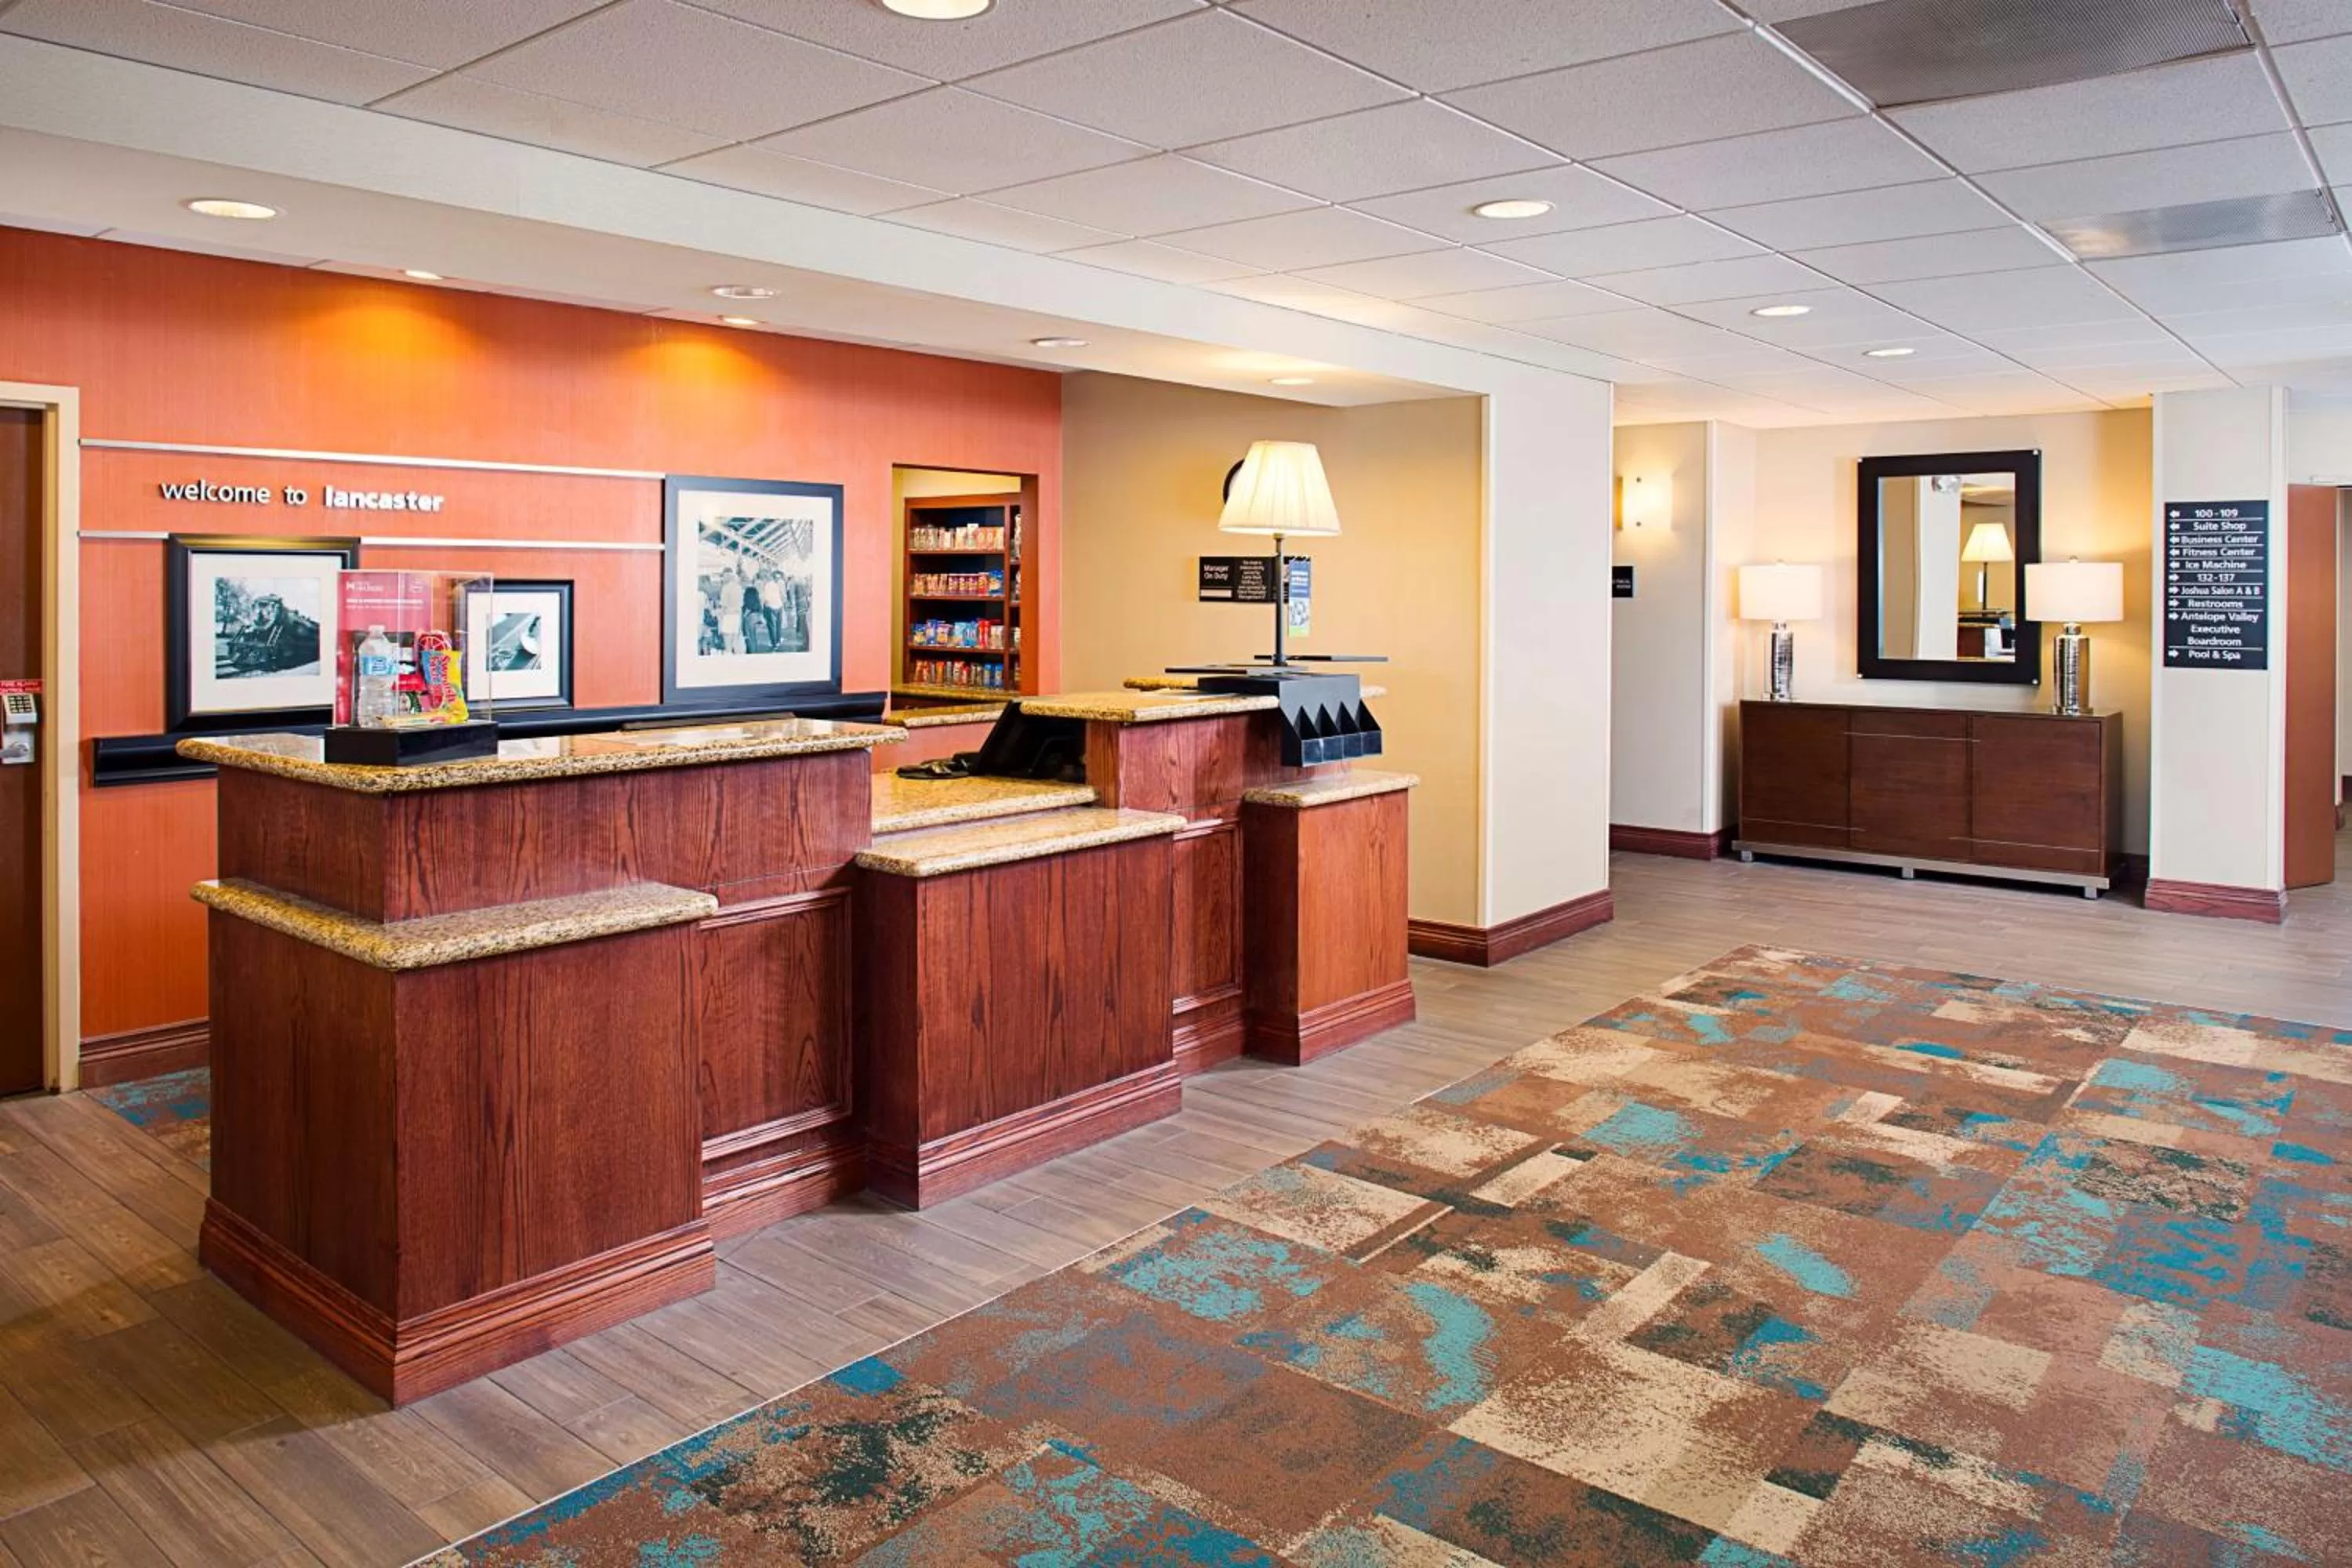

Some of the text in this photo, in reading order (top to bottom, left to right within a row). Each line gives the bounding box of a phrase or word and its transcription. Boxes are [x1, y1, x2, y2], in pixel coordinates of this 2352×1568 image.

[159, 479, 445, 512] welcome to lancaster
[2193, 521, 2247, 532] Suite Shop
[2180, 535, 2259, 544] Business Center
[2220, 548, 2256, 557] Center
[2185, 561, 2247, 569] Ice Machine
[2180, 586, 2261, 595] Joshua Salon A & B
[2187, 599, 2244, 608] Restrooms
[2180, 612, 2259, 623] Antelope Valley
[2190, 624, 2241, 634] Executive
[2187, 636, 2242, 646] Boardroom
[2188, 650, 2241, 661] Pool & Spa
